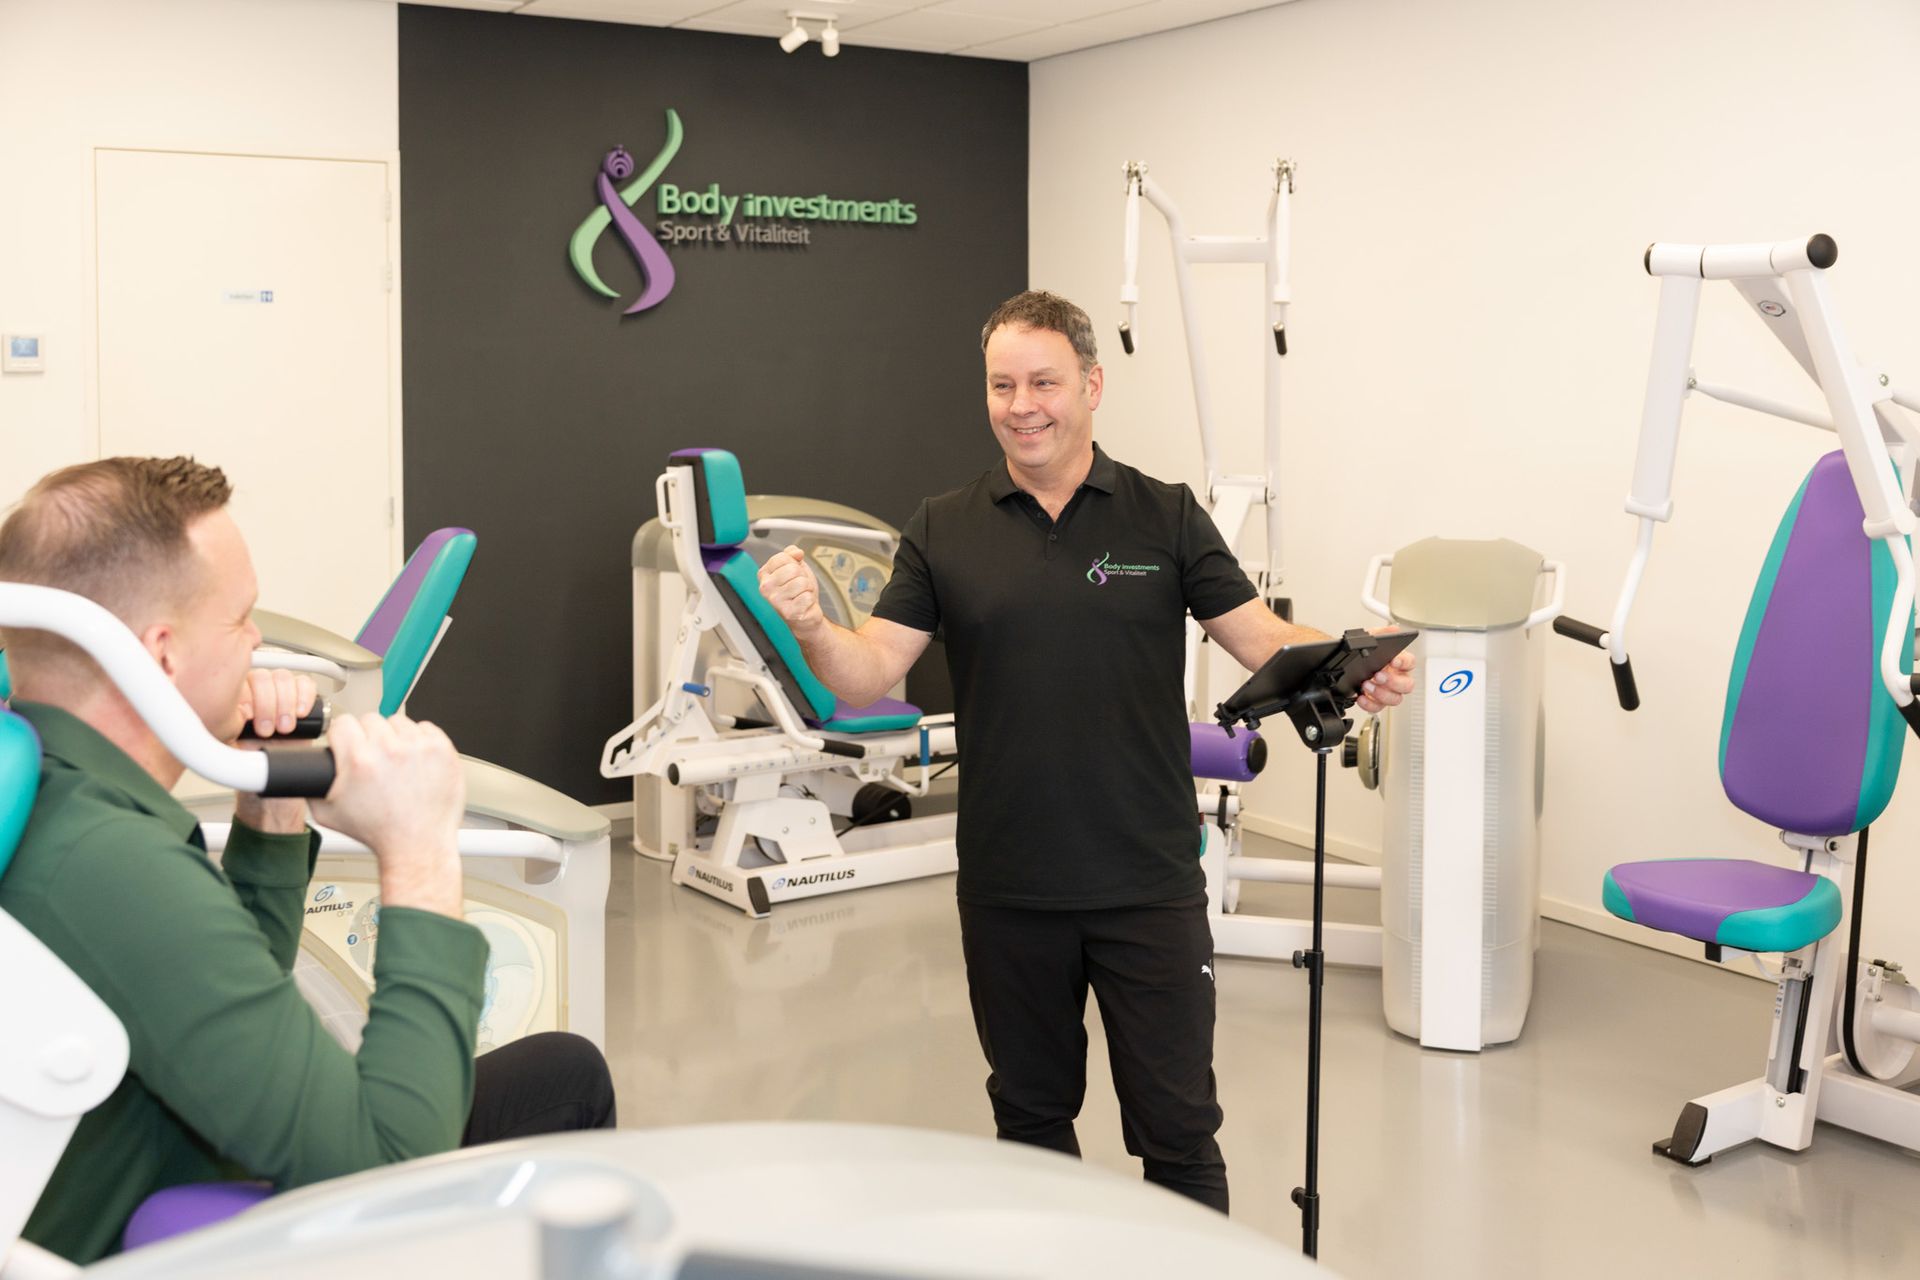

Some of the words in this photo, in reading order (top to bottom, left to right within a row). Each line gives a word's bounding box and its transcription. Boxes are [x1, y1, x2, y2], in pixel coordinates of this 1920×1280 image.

[657, 183, 740, 225] Body
[743, 193, 918, 225] investments
[659, 221, 713, 244] Sport
[716, 225, 731, 241] &
[736, 223, 811, 245] Vitaliteit
[695, 870, 734, 892] NAUTILUS
[787, 869, 856, 888] NAUTILUS
[304, 901, 354, 914] AUTILUS
